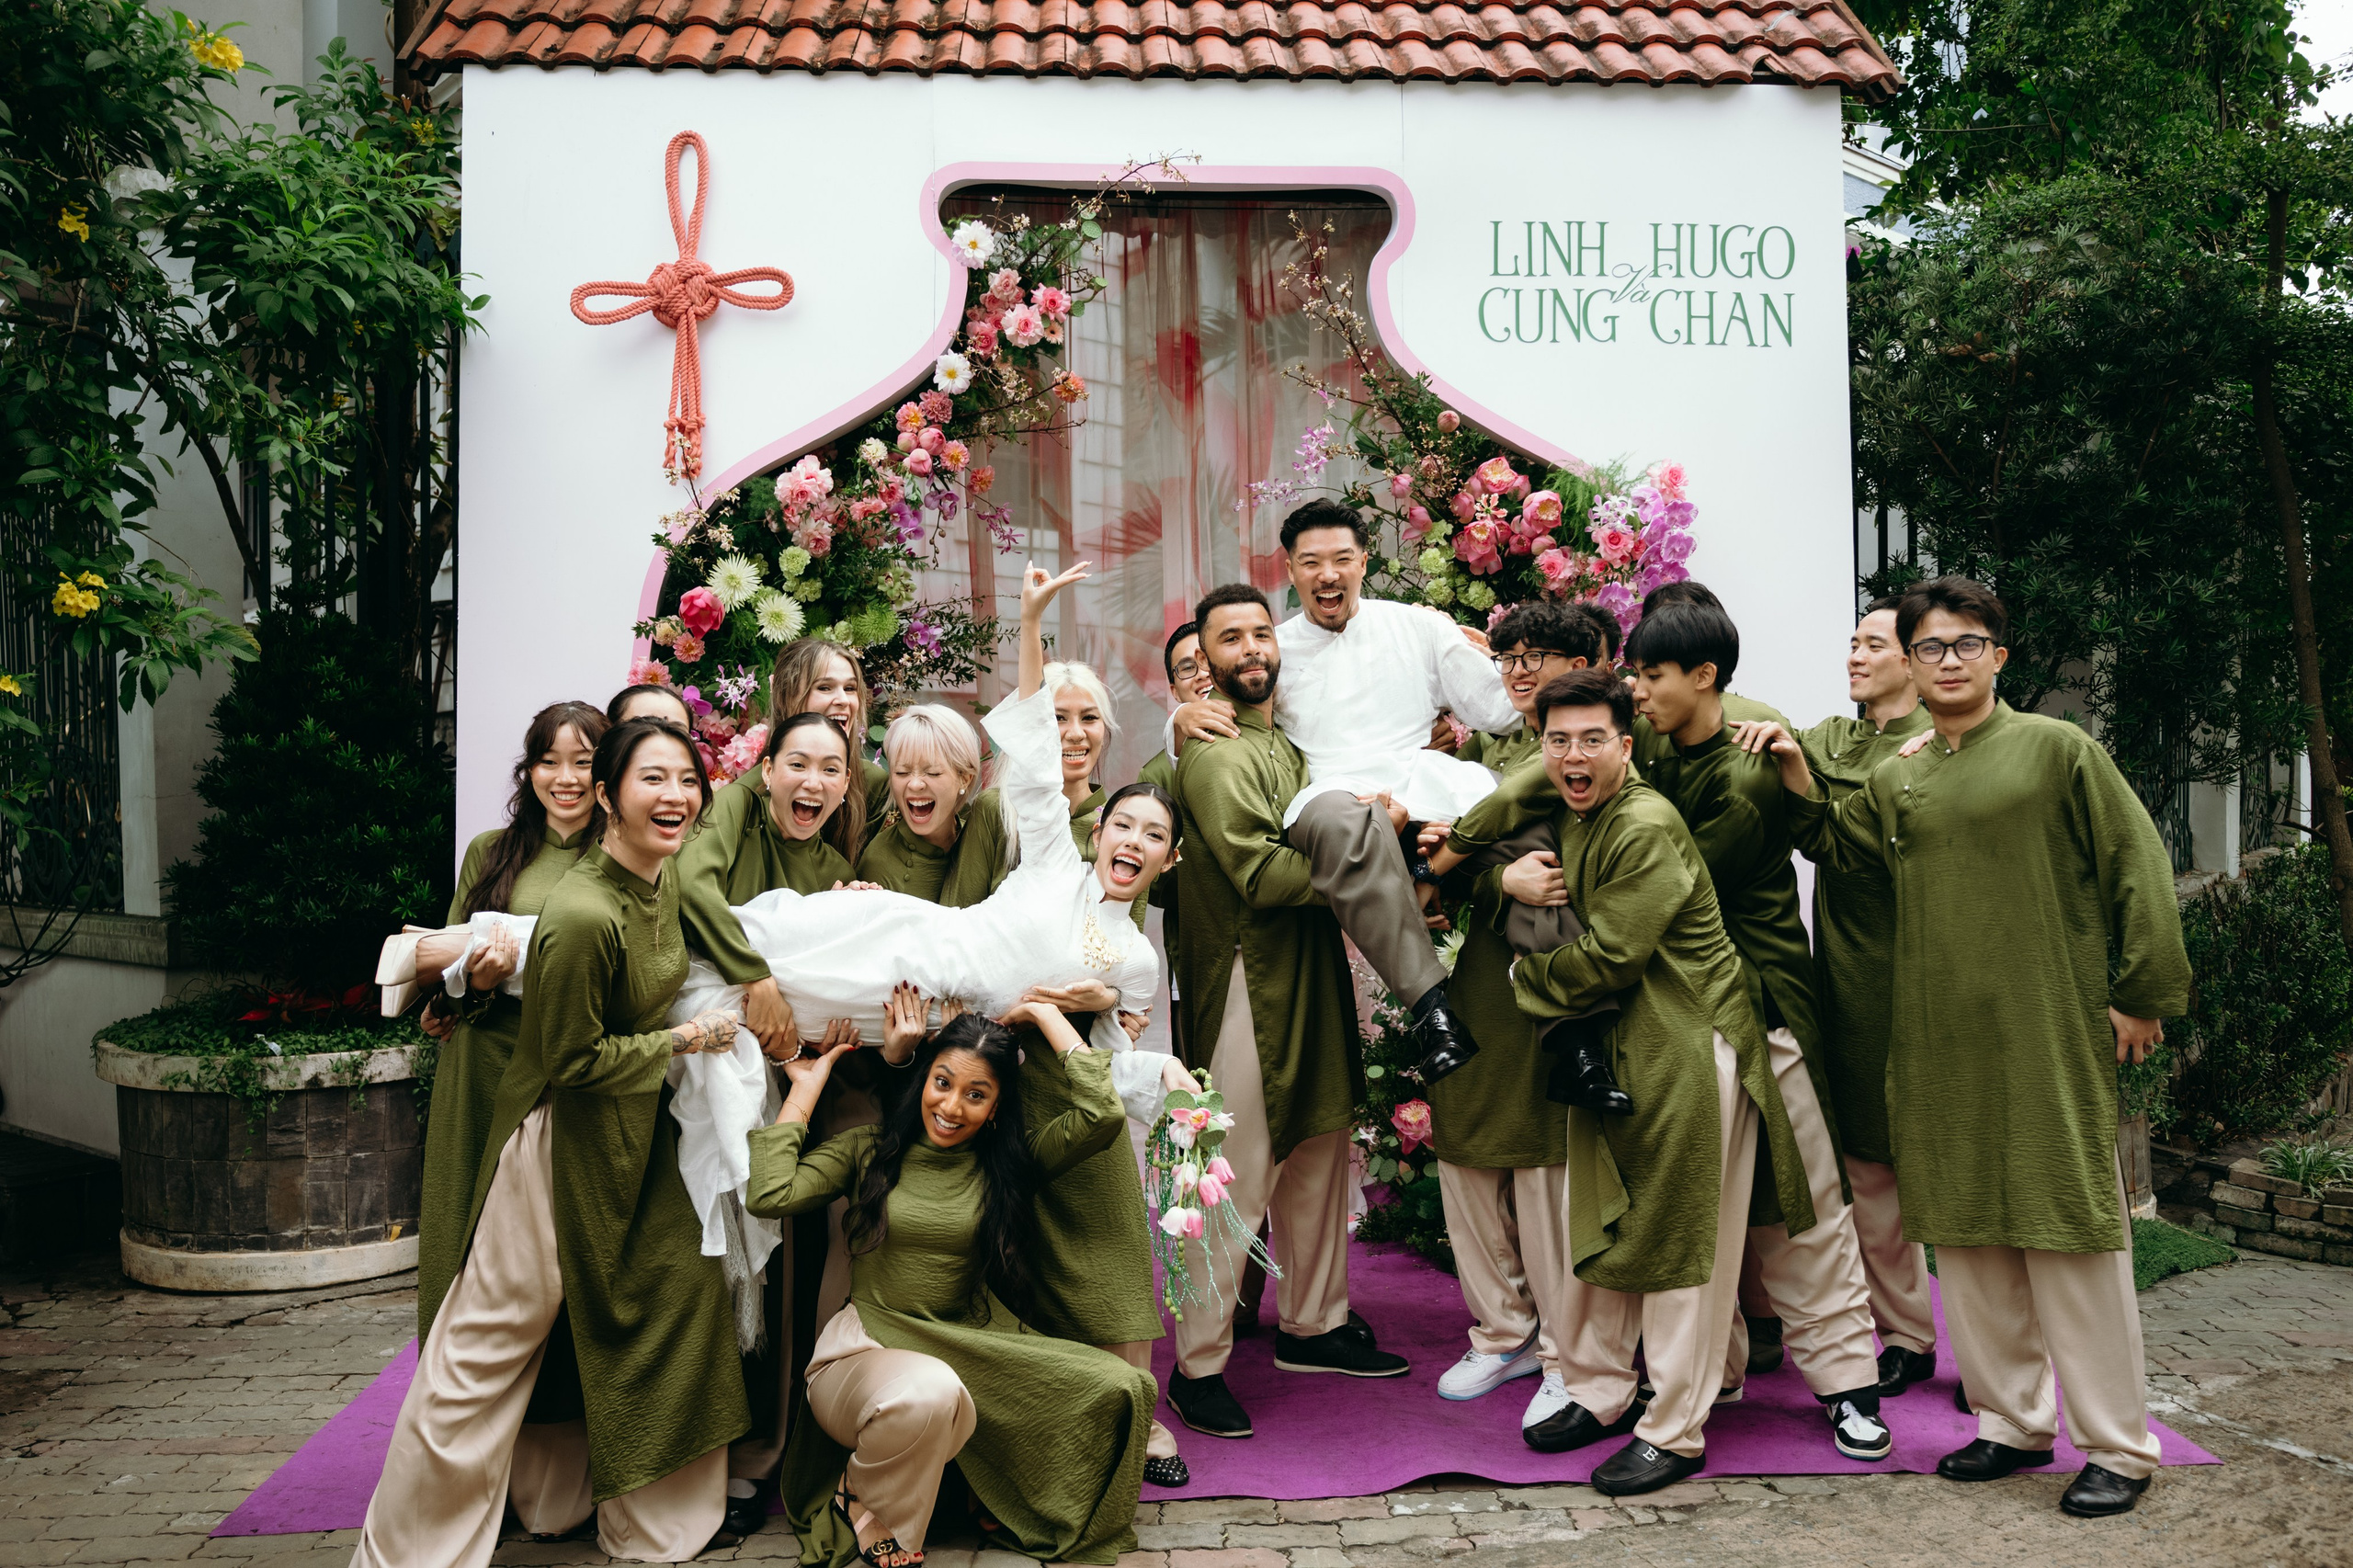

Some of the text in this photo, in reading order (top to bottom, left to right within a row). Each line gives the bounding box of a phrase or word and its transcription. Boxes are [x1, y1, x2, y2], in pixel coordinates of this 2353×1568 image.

[1489, 220, 1796, 280] LINH HUGO
[1477, 286, 1796, 348] CUNG CHAN
